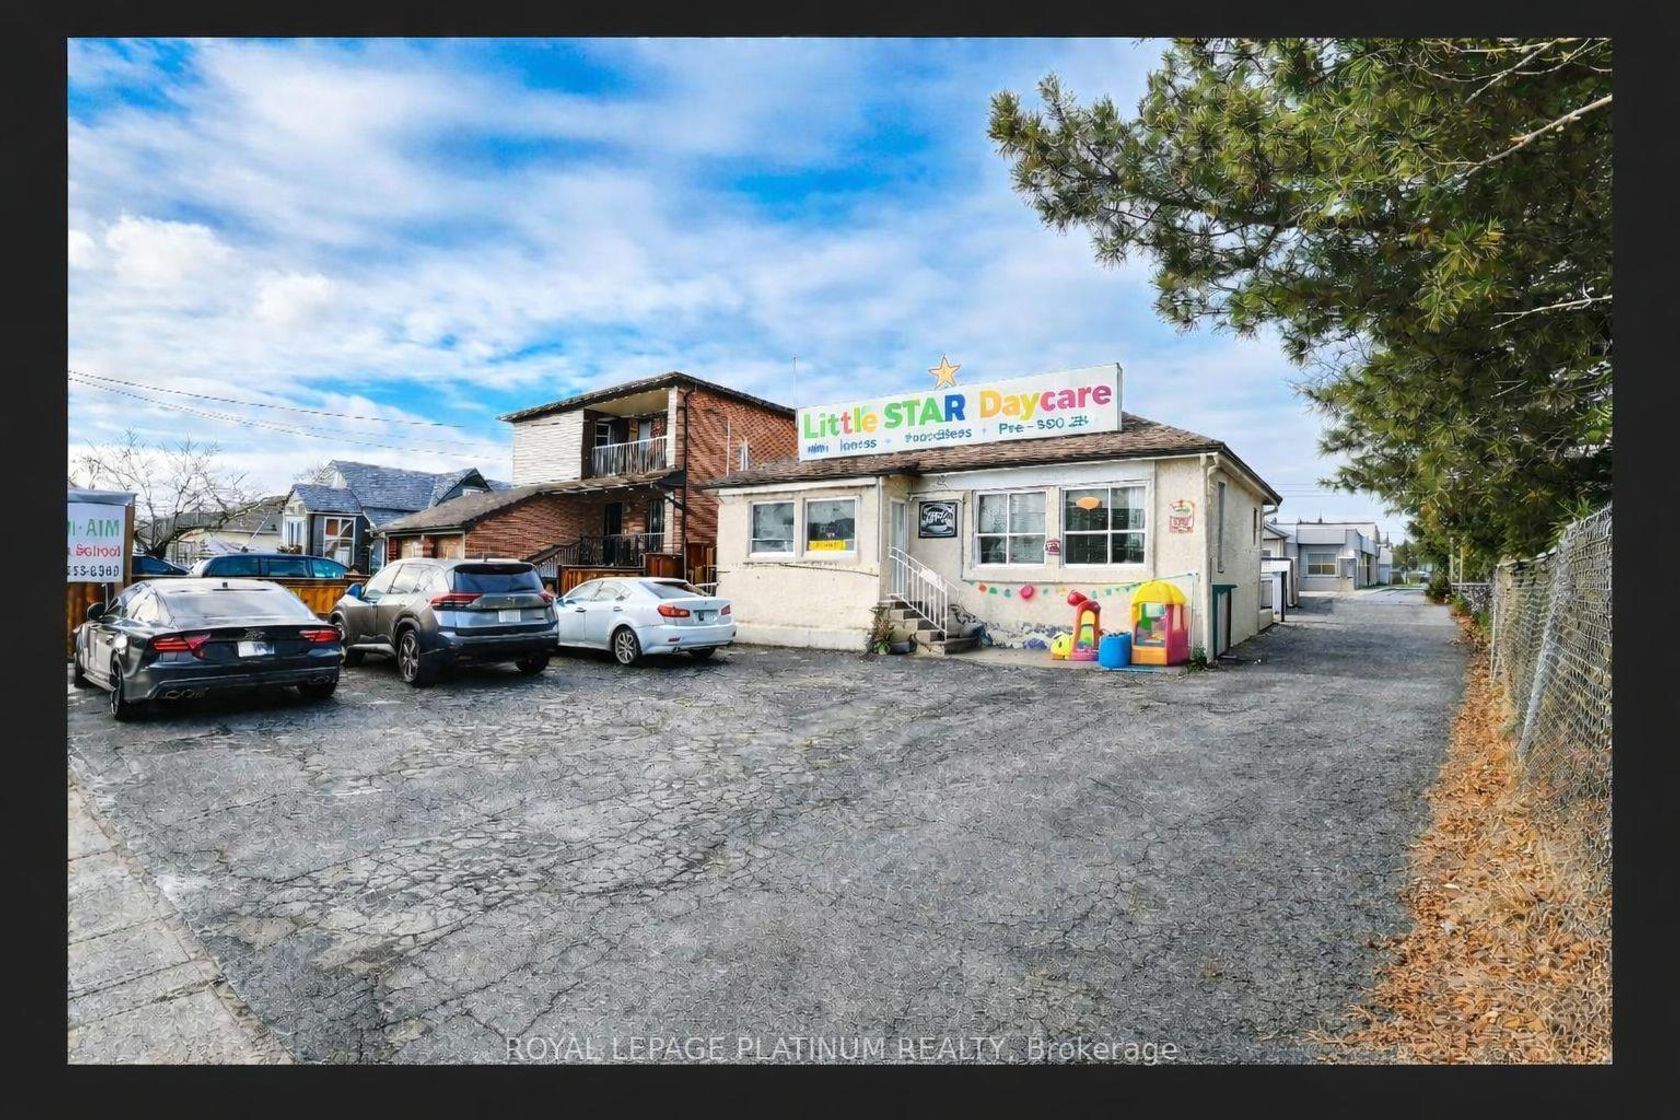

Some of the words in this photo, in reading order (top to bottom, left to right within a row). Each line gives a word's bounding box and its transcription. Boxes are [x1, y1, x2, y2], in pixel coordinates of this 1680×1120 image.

[803, 405, 879, 440] Little
[884, 394, 966, 430] STAR
[979, 383, 1113, 420] Daycare
